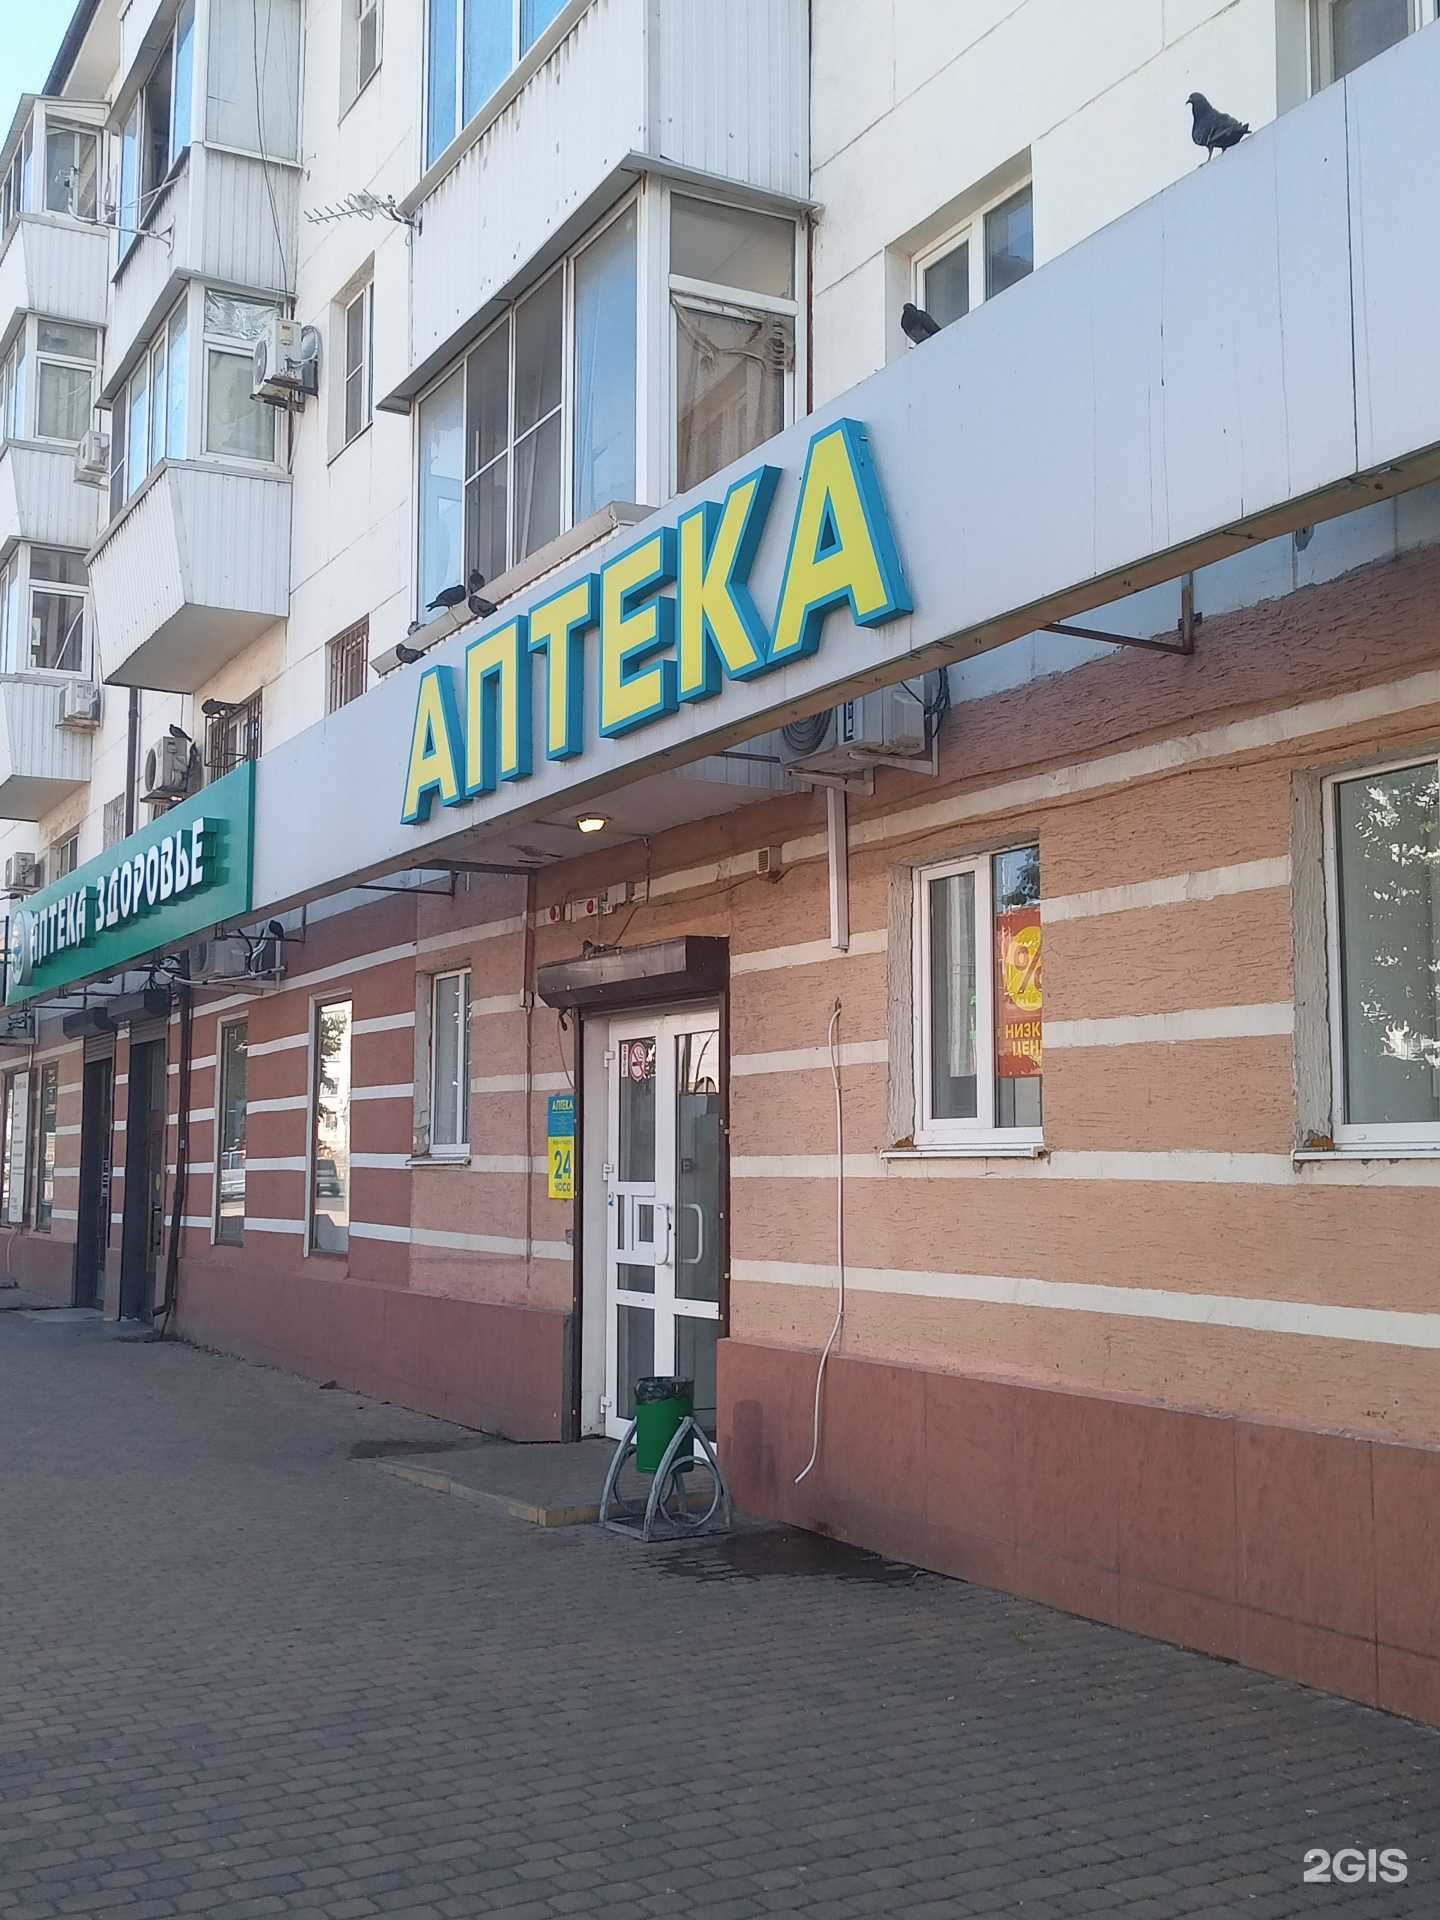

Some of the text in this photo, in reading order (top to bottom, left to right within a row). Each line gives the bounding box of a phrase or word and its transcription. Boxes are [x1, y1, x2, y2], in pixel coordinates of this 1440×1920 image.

[401, 417, 913, 825] АПТЕКА
[30, 816, 207, 968] АПТЕКА ЗДОРОВЬЕ
[554, 1150, 572, 1179] 24
